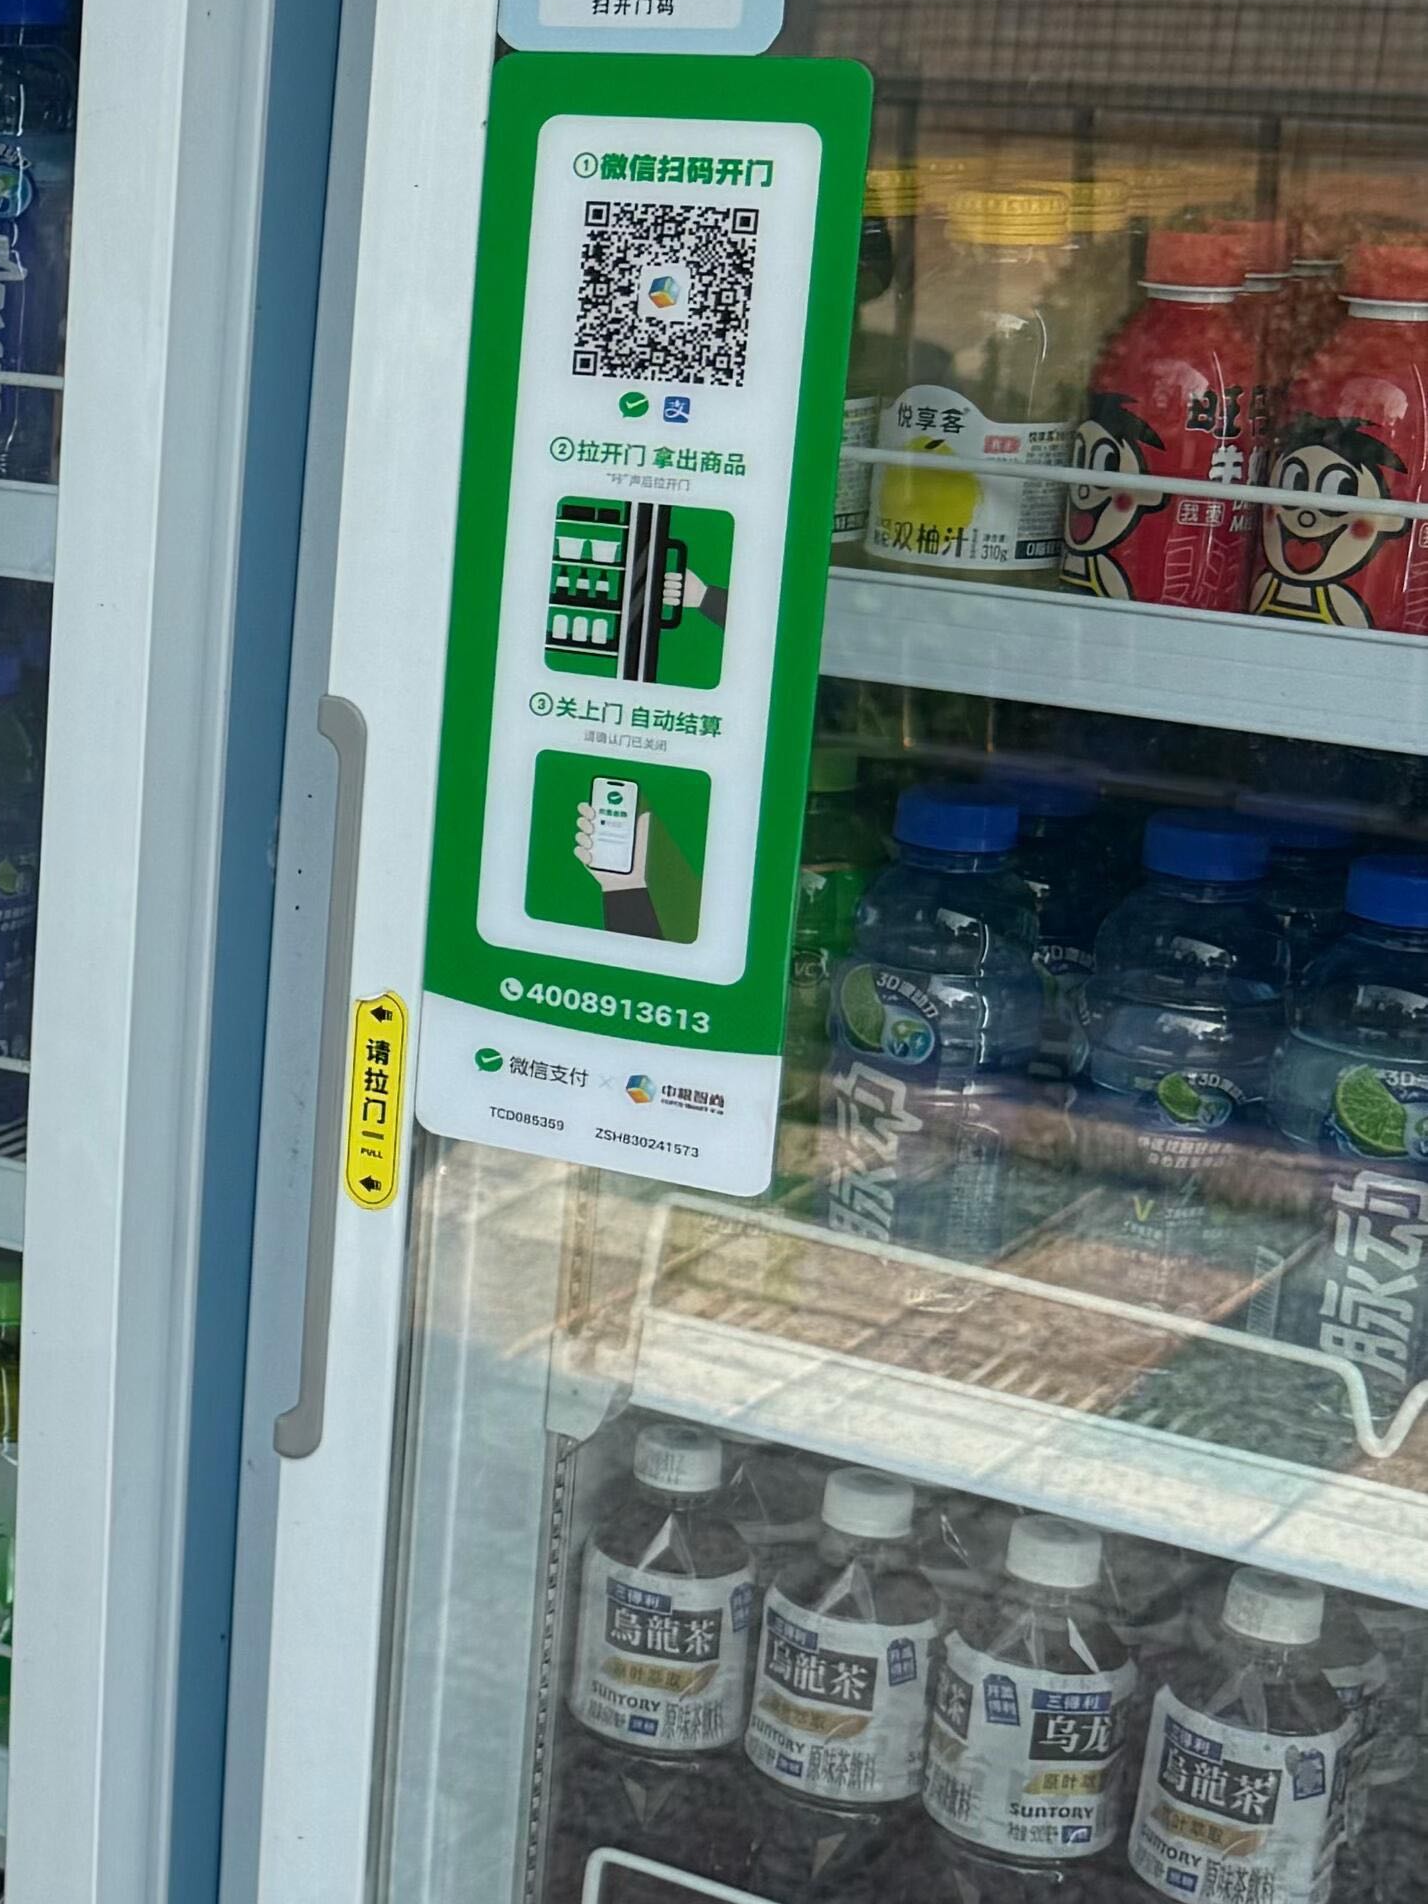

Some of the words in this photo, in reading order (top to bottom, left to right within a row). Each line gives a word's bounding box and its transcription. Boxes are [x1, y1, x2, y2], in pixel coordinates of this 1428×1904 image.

[898, 402, 966, 434] 悦享客
[652, 445, 747, 477] 拿出商品
[893, 521, 970, 558] 双柚汁
[981, 544, 1009, 563] 310g
[630, 706, 723, 738] 自动结算
[527, 986, 711, 1034] 4008913613
[361, 1038, 391, 1125] 请拉门
[509, 1055, 590, 1088] 微信支付
[360, 1147, 384, 1159] PULL
[828, 1060, 924, 1243] 脉动
[1318, 1169, 1428, 1385] 脉动
[610, 1606, 716, 1657] 烏龍茶
[768, 1638, 870, 1701] 烏龍茶
[1046, 1695, 1101, 1711] 三得利
[1038, 1714, 1113, 1753] 乌龙
[1163, 1747, 1275, 1817] 烏龍茶
